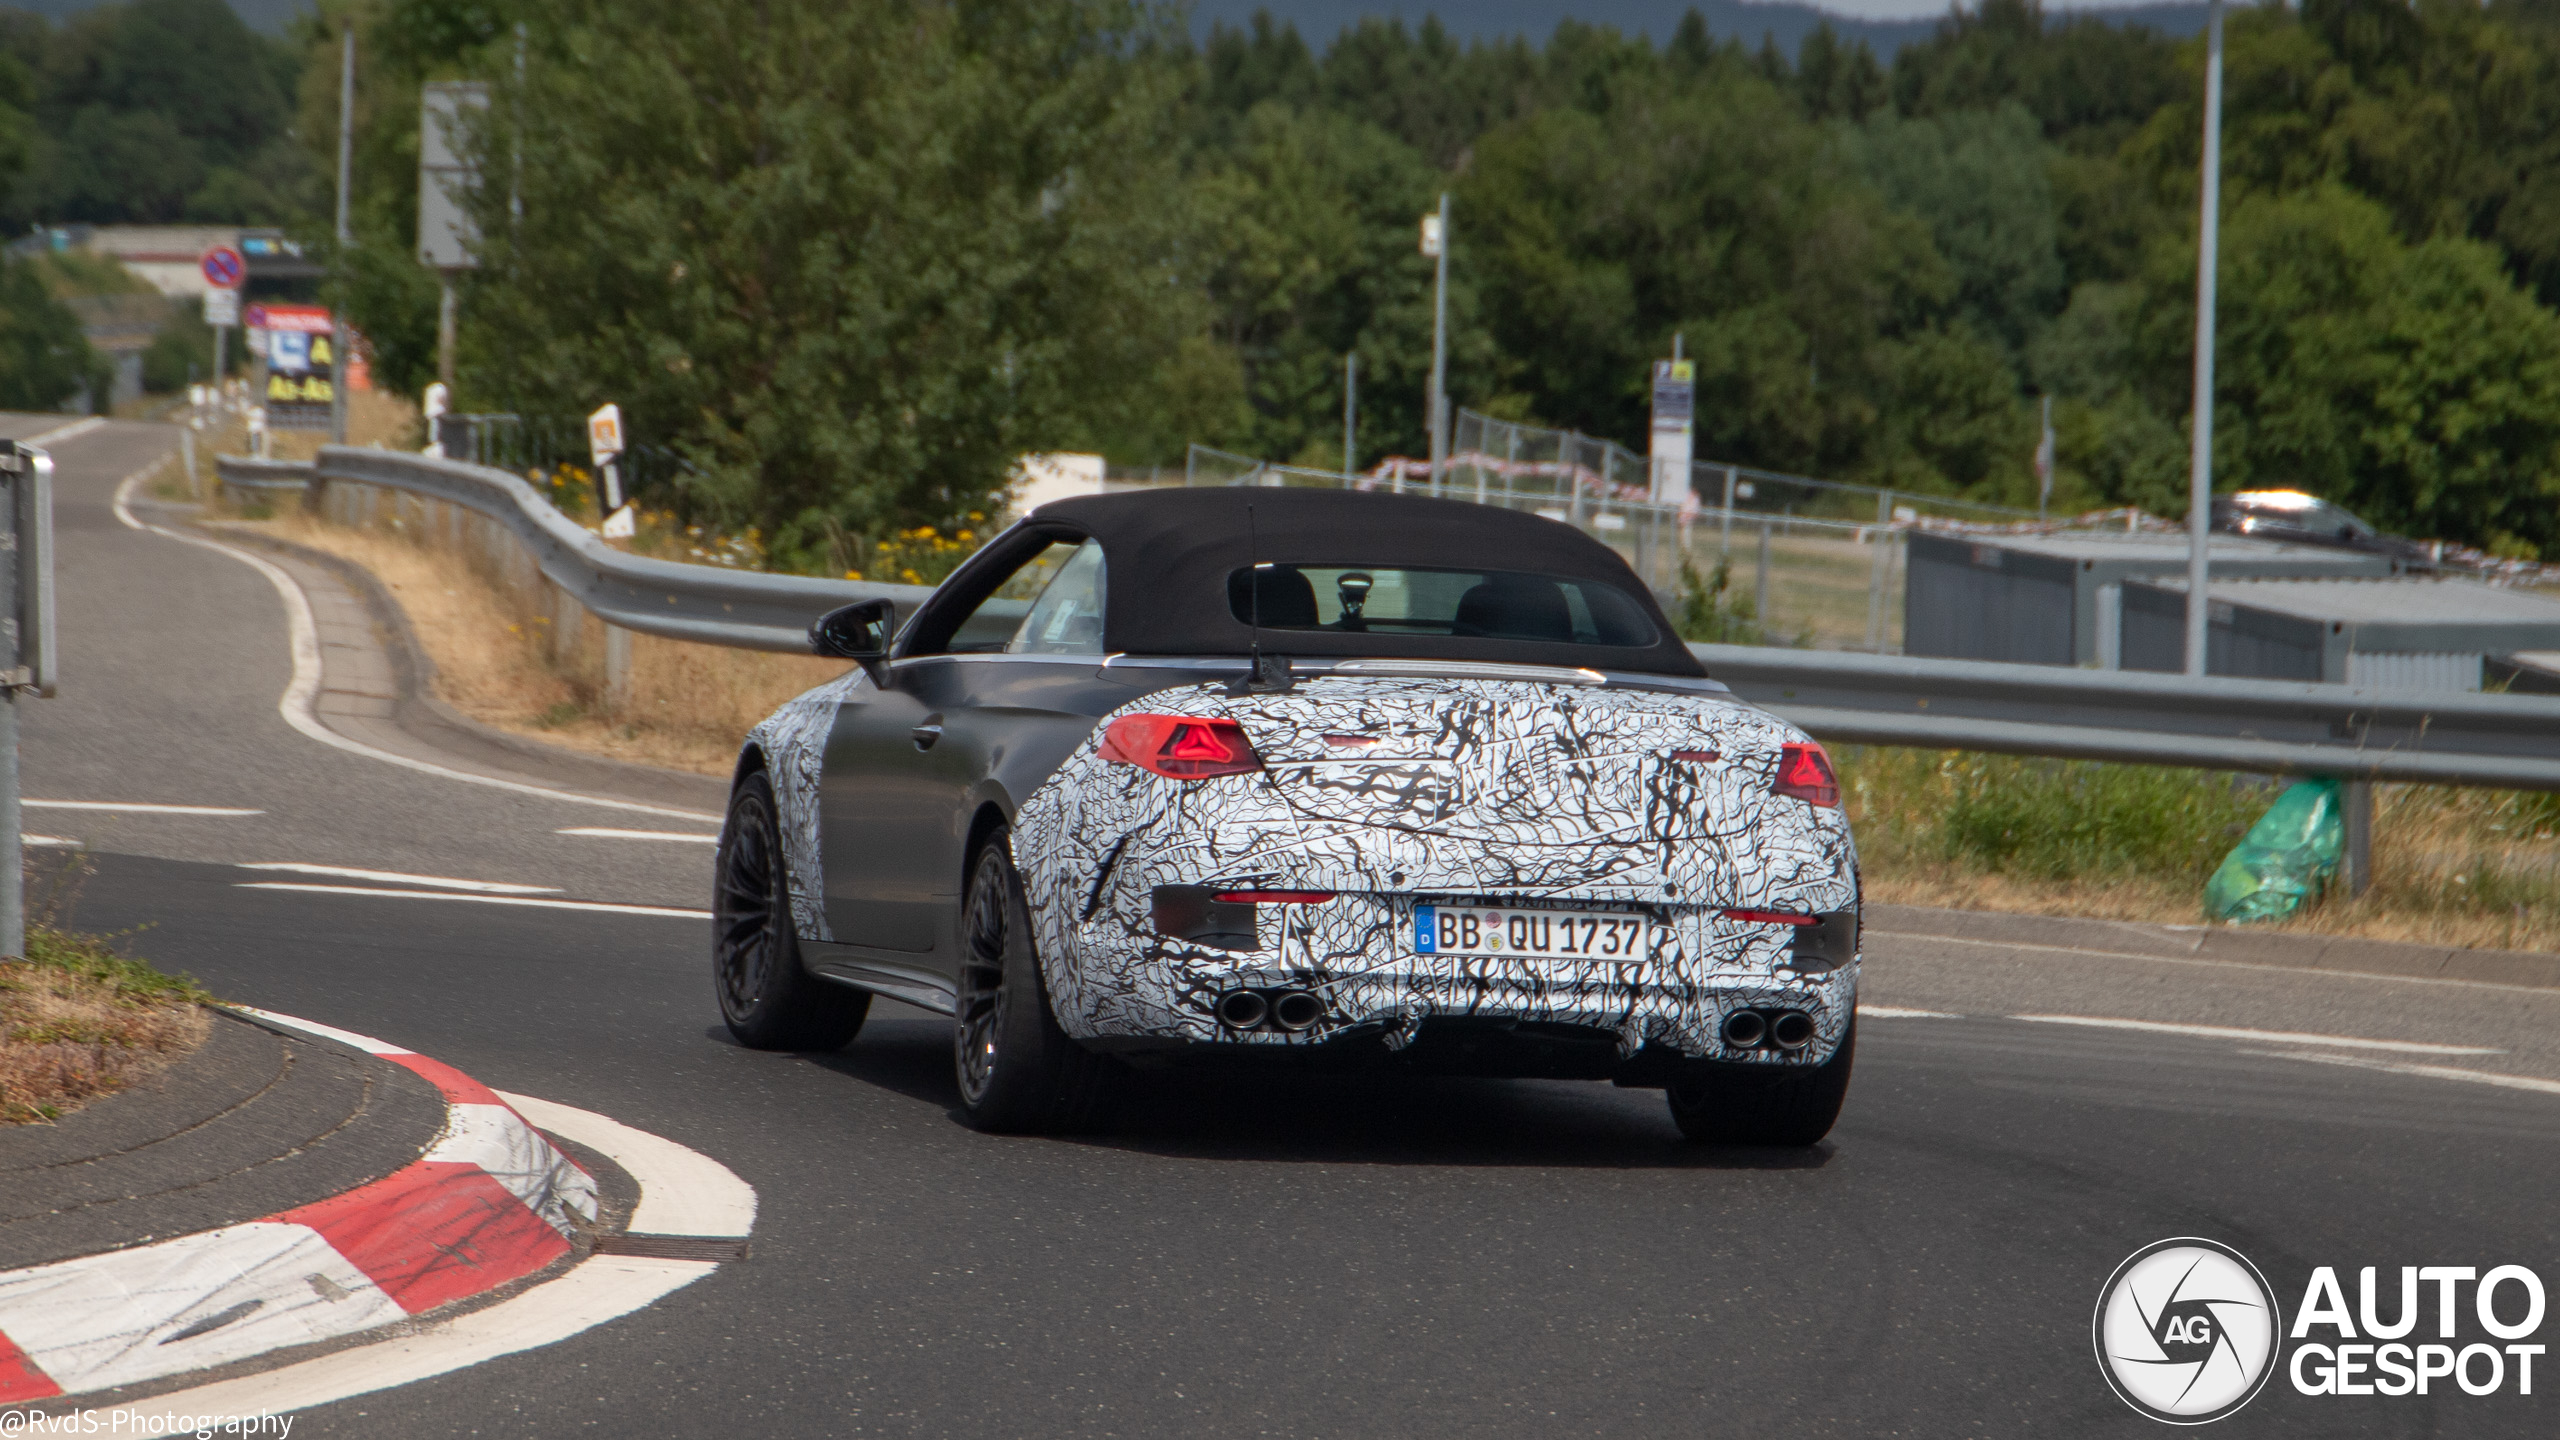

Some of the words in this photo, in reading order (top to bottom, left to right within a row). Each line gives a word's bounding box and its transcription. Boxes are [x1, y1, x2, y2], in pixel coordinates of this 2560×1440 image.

[1420, 934, 1430, 945] D
[1438, 912, 1481, 949] BB
[1508, 915, 1551, 952] QU
[1560, 917, 1641, 955] 1737
